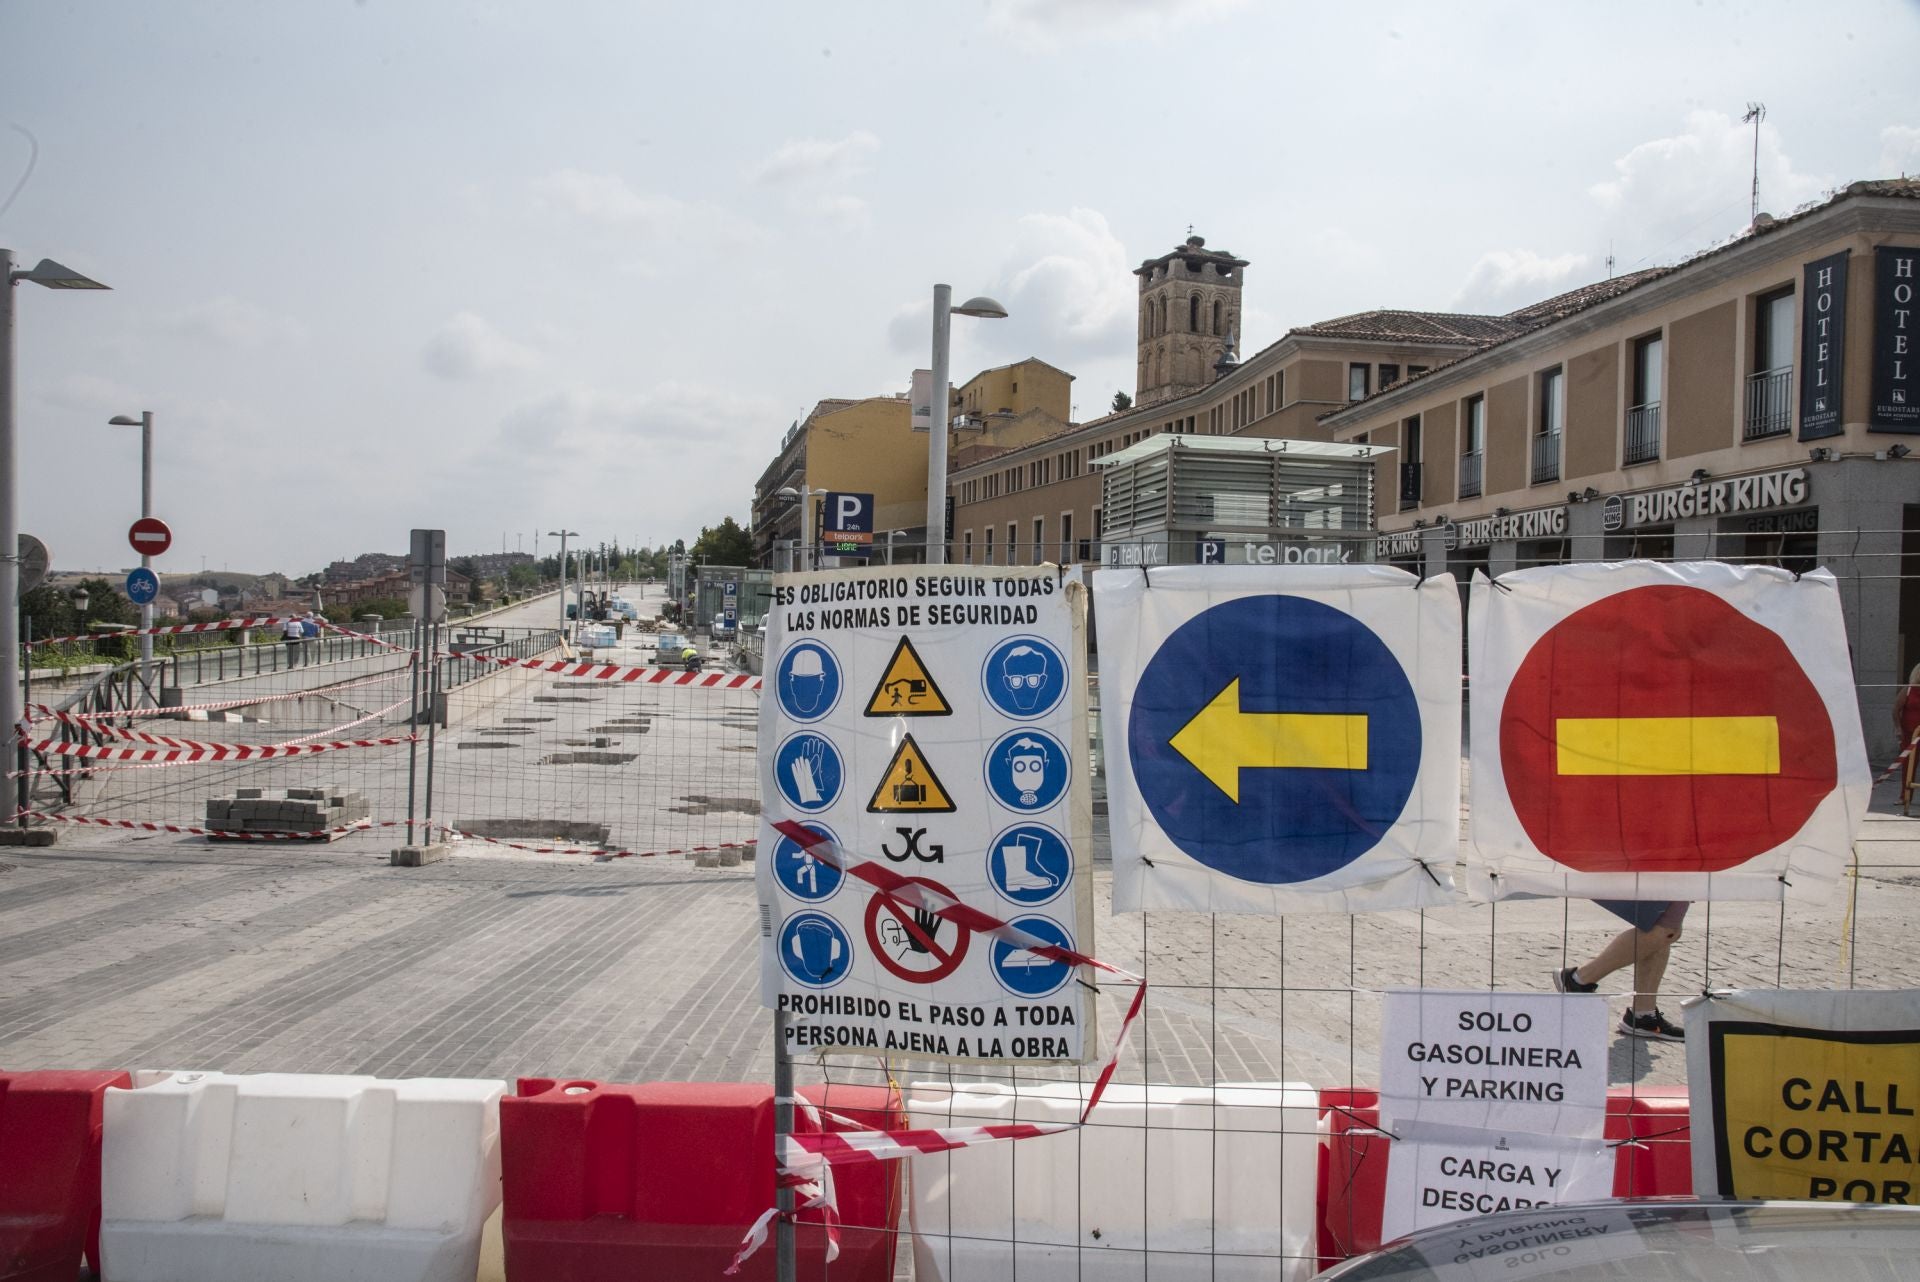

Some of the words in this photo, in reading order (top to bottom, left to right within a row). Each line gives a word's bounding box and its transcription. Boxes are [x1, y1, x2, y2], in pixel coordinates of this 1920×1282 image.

[1817, 266, 1832, 387] HOTEL
[1893, 258, 1914, 380] HOTEL
[836, 495, 862, 530] P
[1633, 484, 1727, 524] BURGER
[1731, 468, 1807, 512] KING
[1463, 514, 1521, 546] BURGER
[1522, 506, 1567, 537] KING
[1391, 532, 1420, 556] KING
[776, 586, 795, 606] ES
[801, 577, 908, 604] OBLIGATORIO
[916, 575, 986, 597] SEGUIR
[993, 576, 1054, 597] TODAS
[788, 612, 815, 632] LAS
[821, 607, 890, 630] NORMAS
[898, 606, 921, 626] DE
[928, 604, 1038, 626] SEGURIDAD
[778, 994, 891, 1019] PROHIBIDO
[899, 1002, 923, 1024] EL
[930, 1004, 985, 1027] PASO
[993, 1006, 1008, 1027] A
[1015, 1005, 1075, 1026] TODA
[1458, 1010, 1533, 1034] SOLO
[785, 1025, 879, 1049] PERSONA
[885, 1028, 949, 1055] AJENA
[957, 1037, 970, 1057] A
[978, 1038, 1004, 1058] LA
[1012, 1036, 1070, 1058] OBRA
[1407, 1041, 1583, 1070] GASOLINERA
[1421, 1077, 1439, 1096] Y
[1445, 1078, 1565, 1102] PARKING
[1782, 1077, 1915, 1116] CALL
[1743, 1126, 1920, 1165] CORTA
[1440, 1155, 1535, 1186] CARGA
[1544, 1167, 1562, 1187] Y
[1809, 1177, 1912, 1205] POR
